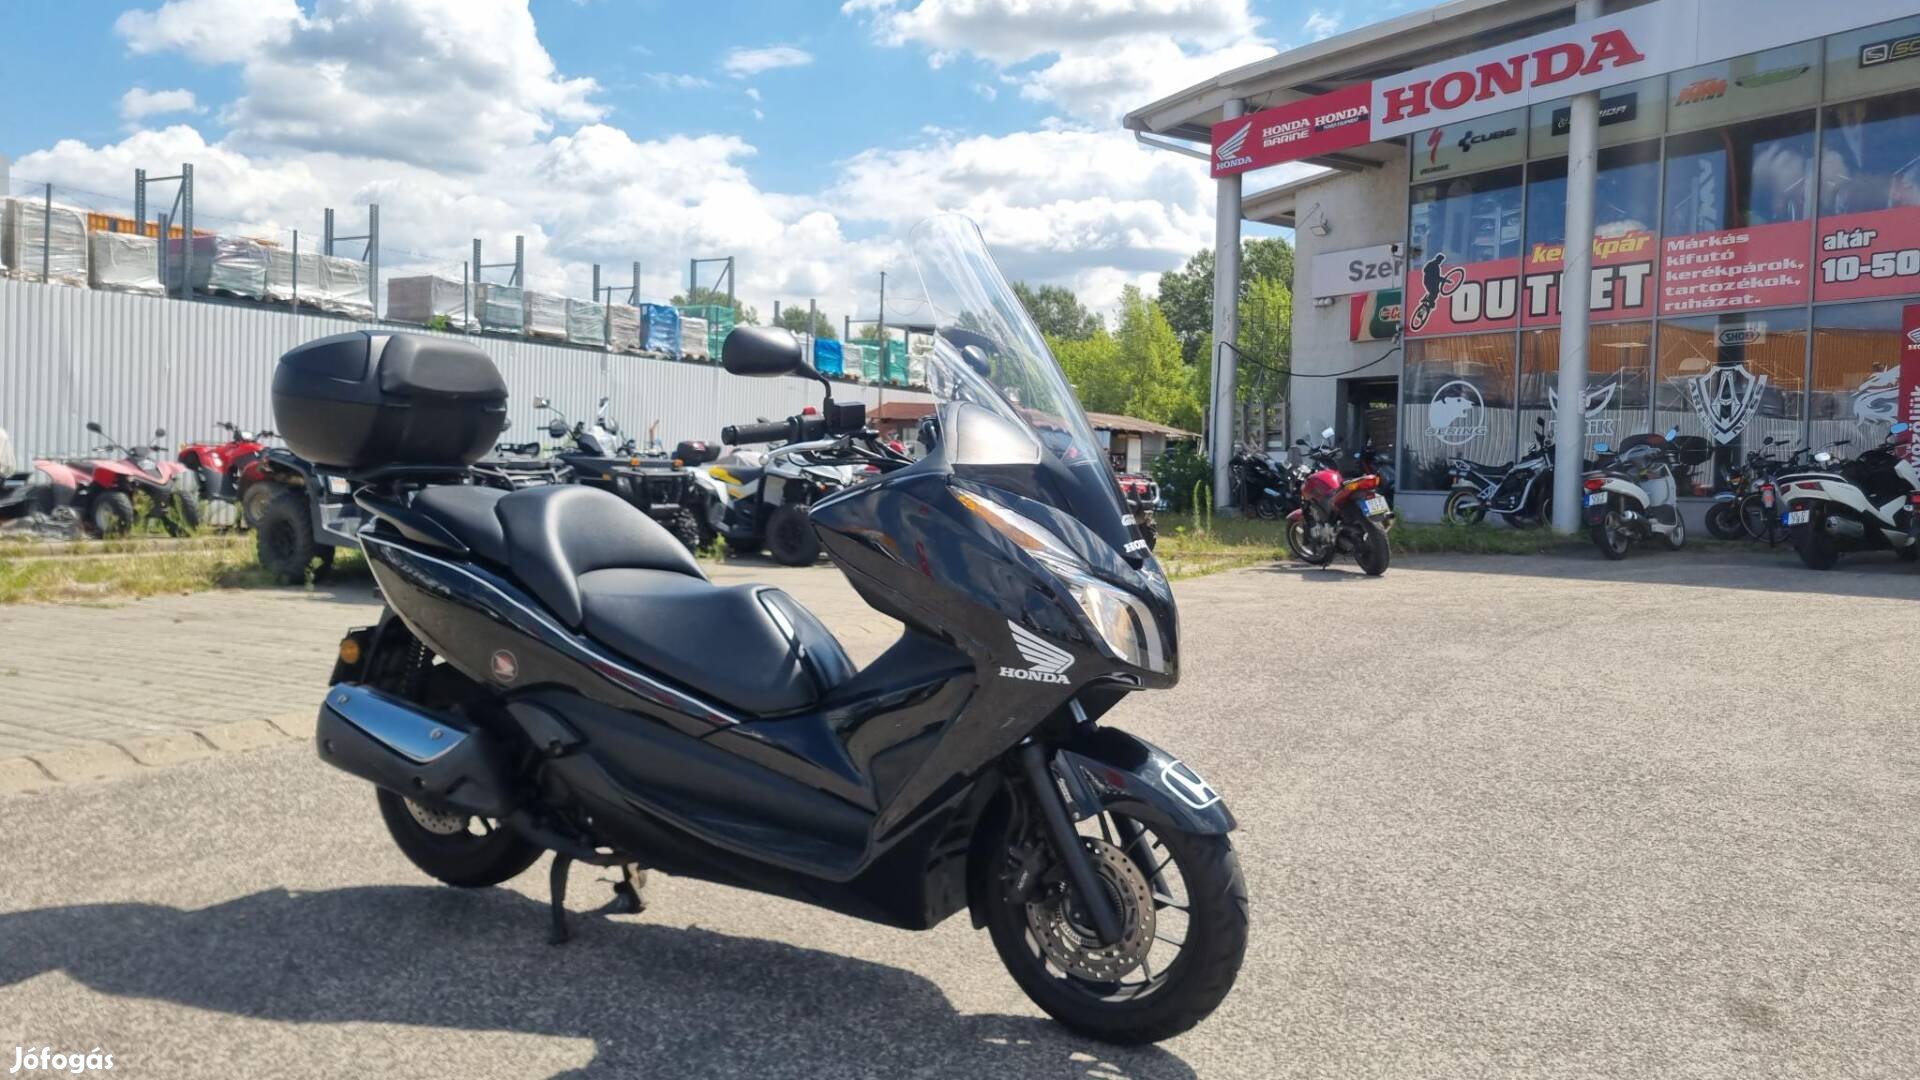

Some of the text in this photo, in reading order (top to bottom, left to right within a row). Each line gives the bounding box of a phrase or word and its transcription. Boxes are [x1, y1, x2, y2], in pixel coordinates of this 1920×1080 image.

[1382, 29, 1645, 124] HONDA
[1314, 105, 1369, 127] HONDA
[1262, 118, 1310, 138] HONDA
[1471, 127, 1517, 144] CUBE
[1216, 156, 1253, 171] HONDA
[1531, 234, 1650, 264] kekpár
[1667, 233, 1749, 252] Márkás
[1823, 228, 1877, 251] akár
[1666, 249, 1735, 266] kifutó
[1821, 249, 1920, 282] 10-50
[1666, 258, 1804, 281] kerékpárok,
[1451, 261, 1652, 322] OUTET
[1665, 274, 1801, 296] tartozékok,
[1664, 294, 1761, 311] ruházat.
[998, 666, 1071, 685] HONDA
